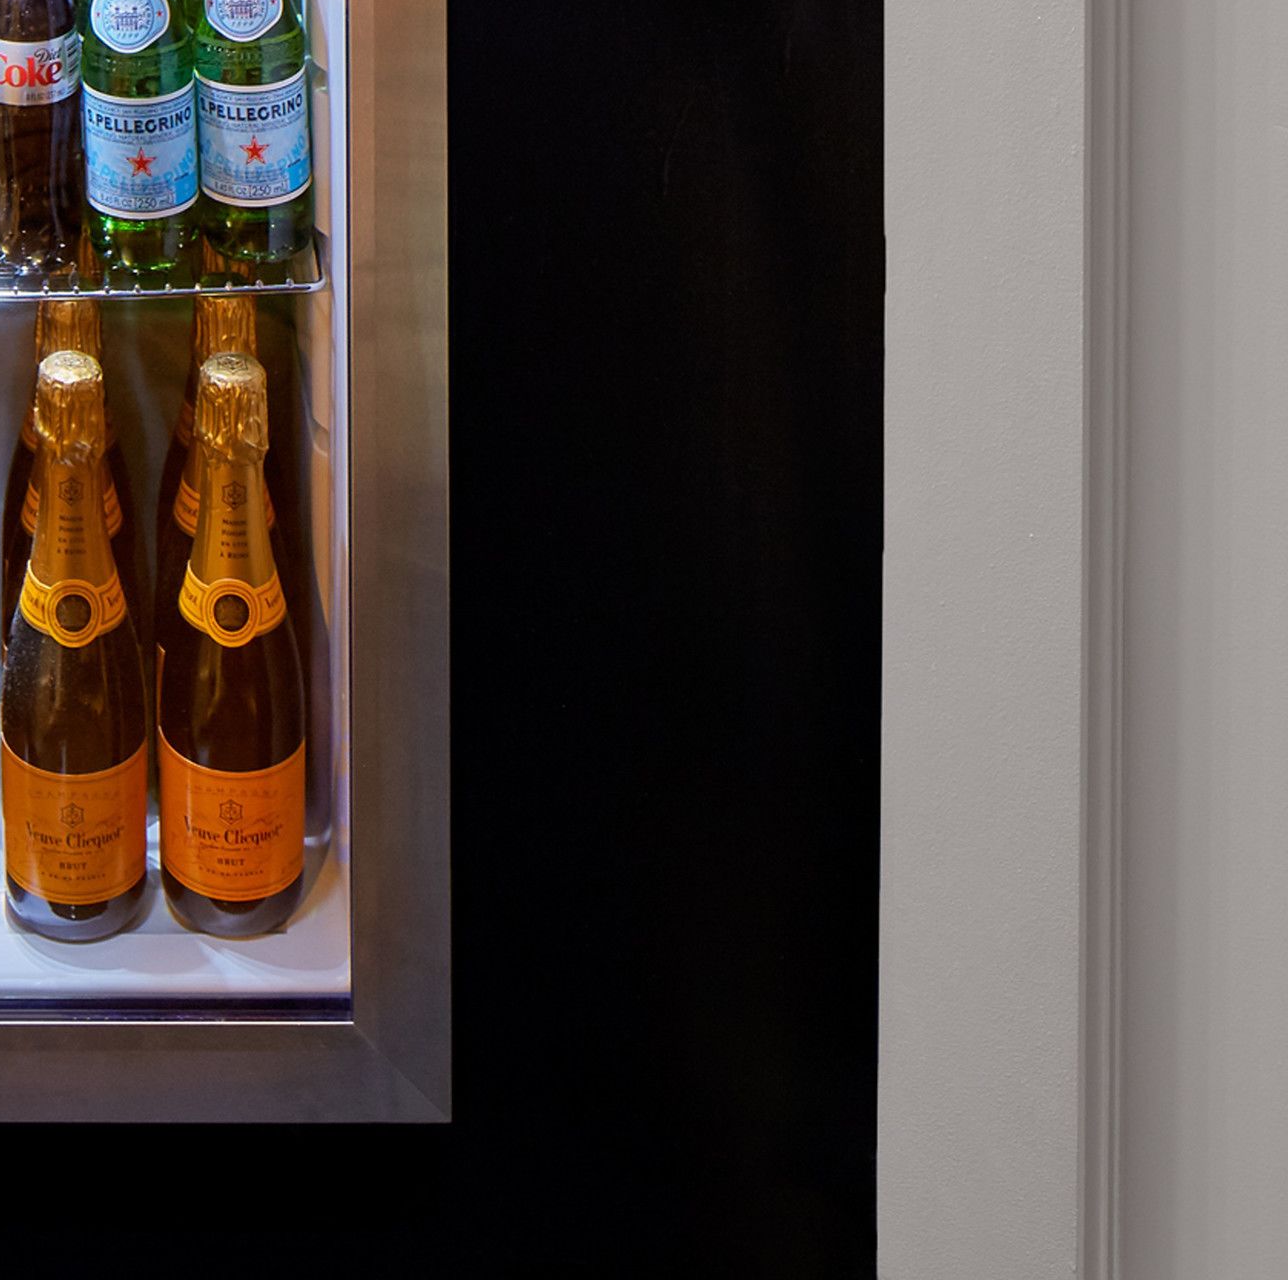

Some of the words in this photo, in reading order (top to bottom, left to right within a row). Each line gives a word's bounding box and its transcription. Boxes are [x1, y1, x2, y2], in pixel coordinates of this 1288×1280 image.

[34, 47, 62, 63] Diet
[26, 821, 63, 845] Veuve
[66, 828, 122, 848] Clicquot
[184, 816, 220, 841] Veuve
[224, 826, 280, 845] Clicquot
[59, 862, 87, 870] BRUT
[217, 858, 245, 866] BRUT
